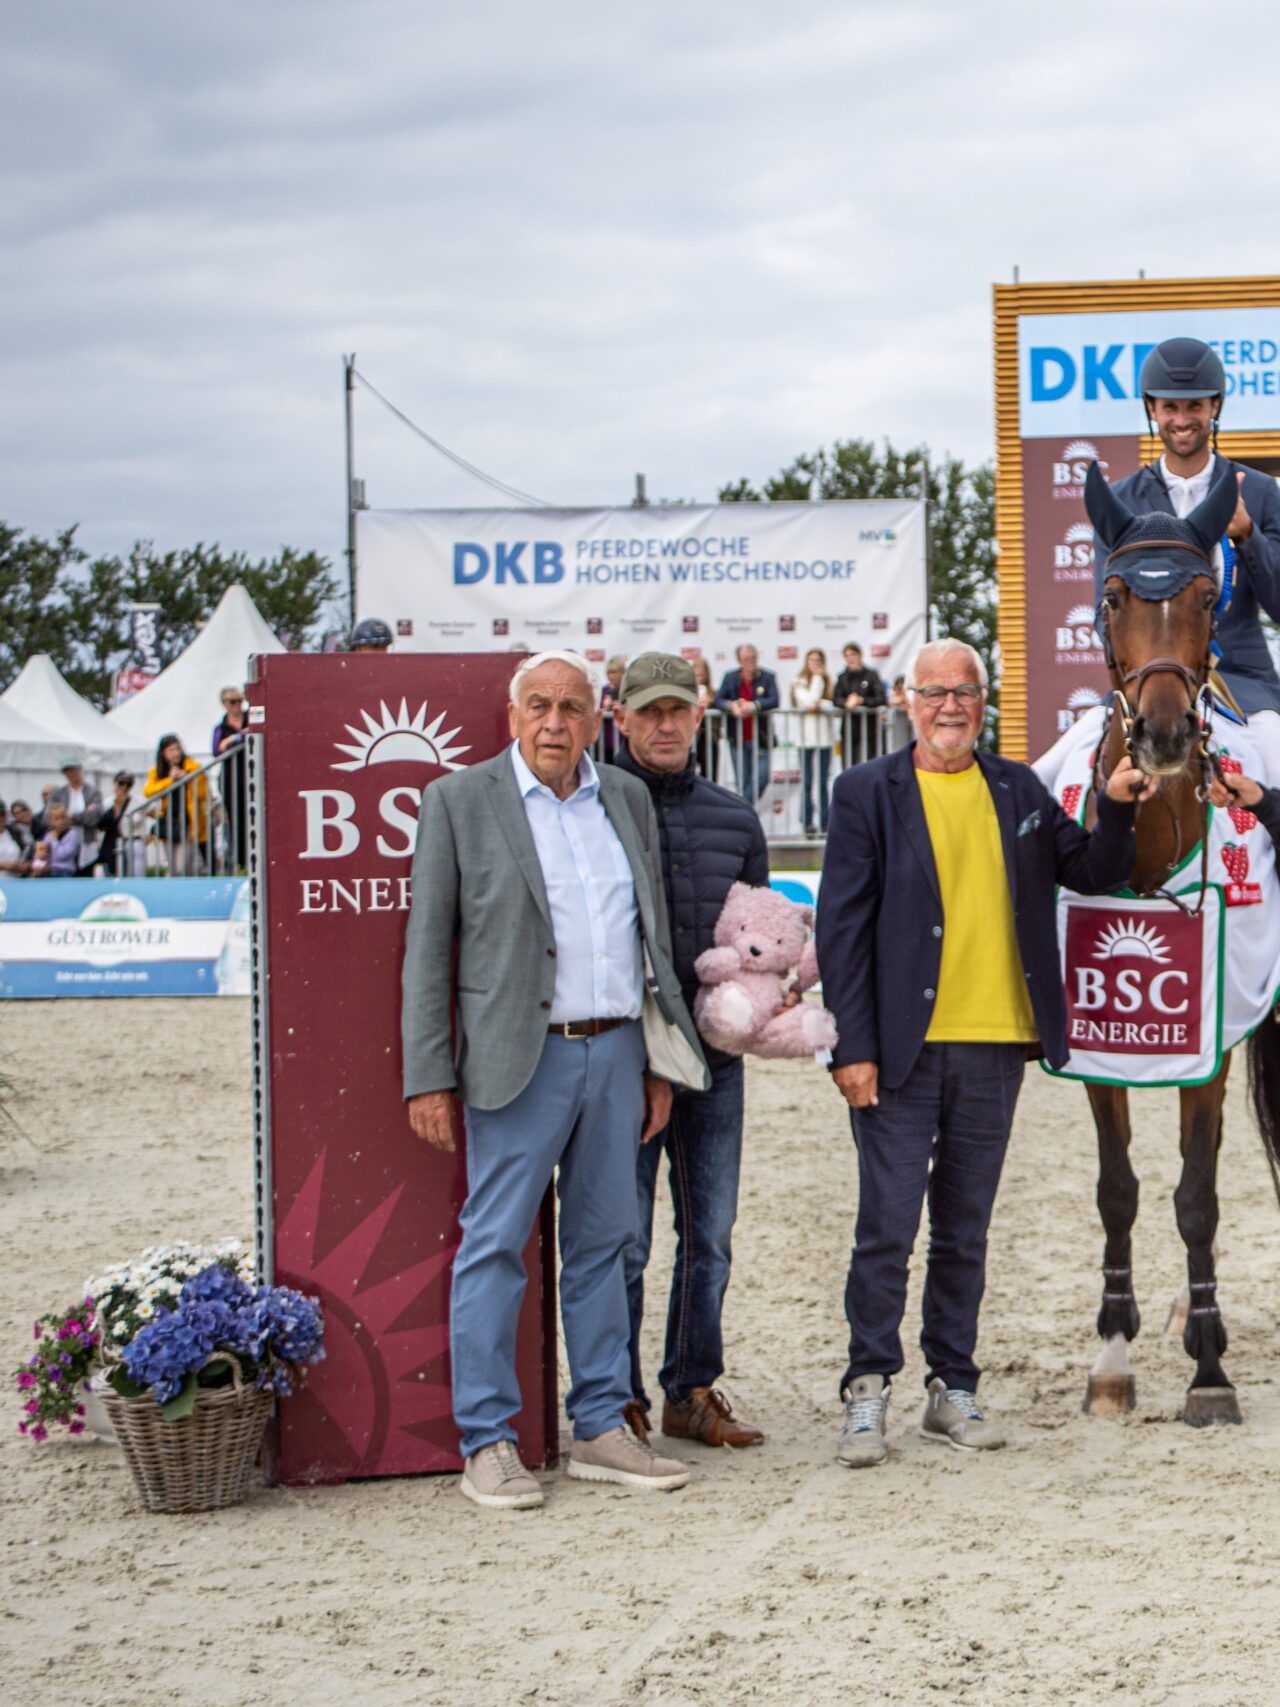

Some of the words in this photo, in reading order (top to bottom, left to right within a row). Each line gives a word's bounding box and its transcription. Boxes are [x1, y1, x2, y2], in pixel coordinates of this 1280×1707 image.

[577, 537, 750, 559] PFERDEWOCHE
[1054, 544, 1096, 568] BS
[453, 541, 565, 585] DKB
[576, 563, 661, 584] HOHEN
[669, 559, 856, 582] WIESCHENDORF
[298, 786, 422, 859] BS
[47, 926, 171, 946] GÜSTROWER
[1073, 966, 1189, 1015] BSC
[1070, 1018, 1188, 1046] ENERGIE
